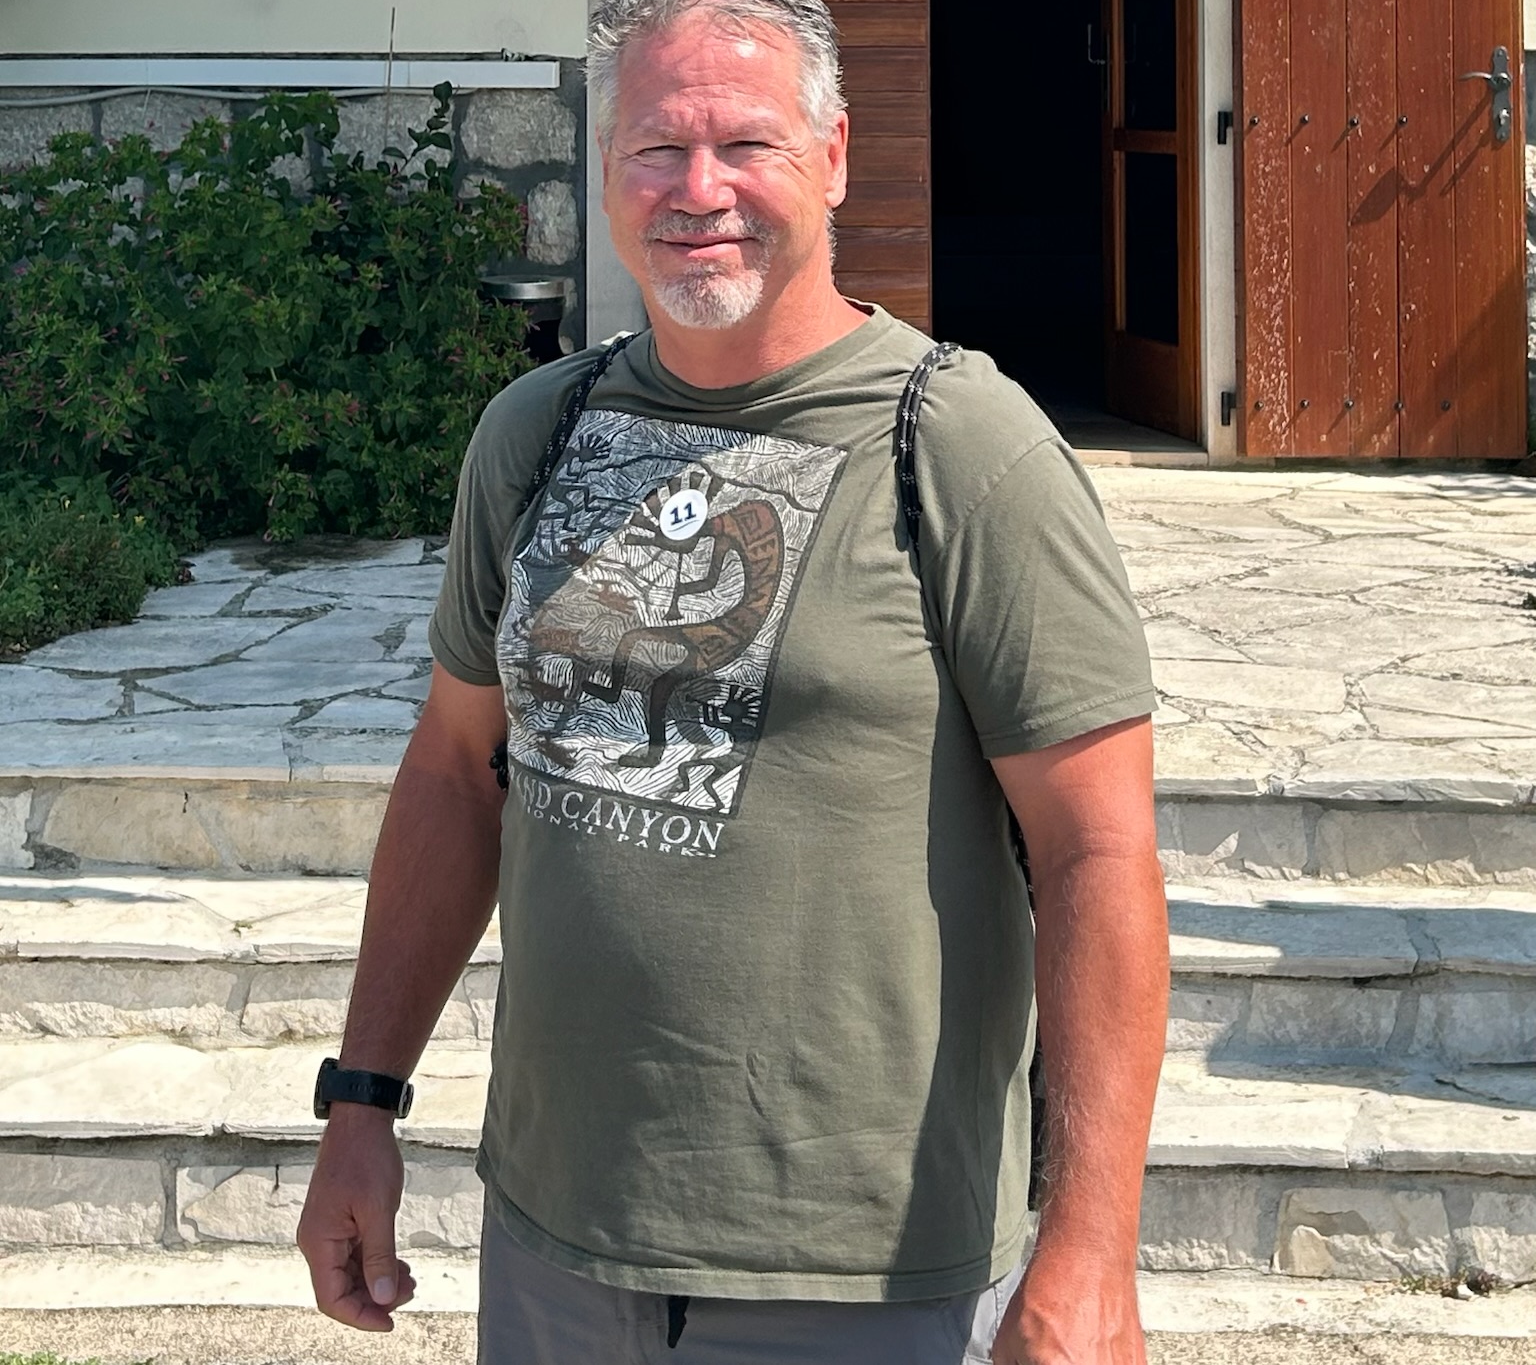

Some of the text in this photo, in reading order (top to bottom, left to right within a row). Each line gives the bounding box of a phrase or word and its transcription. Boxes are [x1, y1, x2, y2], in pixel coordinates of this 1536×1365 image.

[670, 501, 697, 526] 11
[526, 805, 598, 835] IONAL
[561, 791, 725, 851] CANYON
